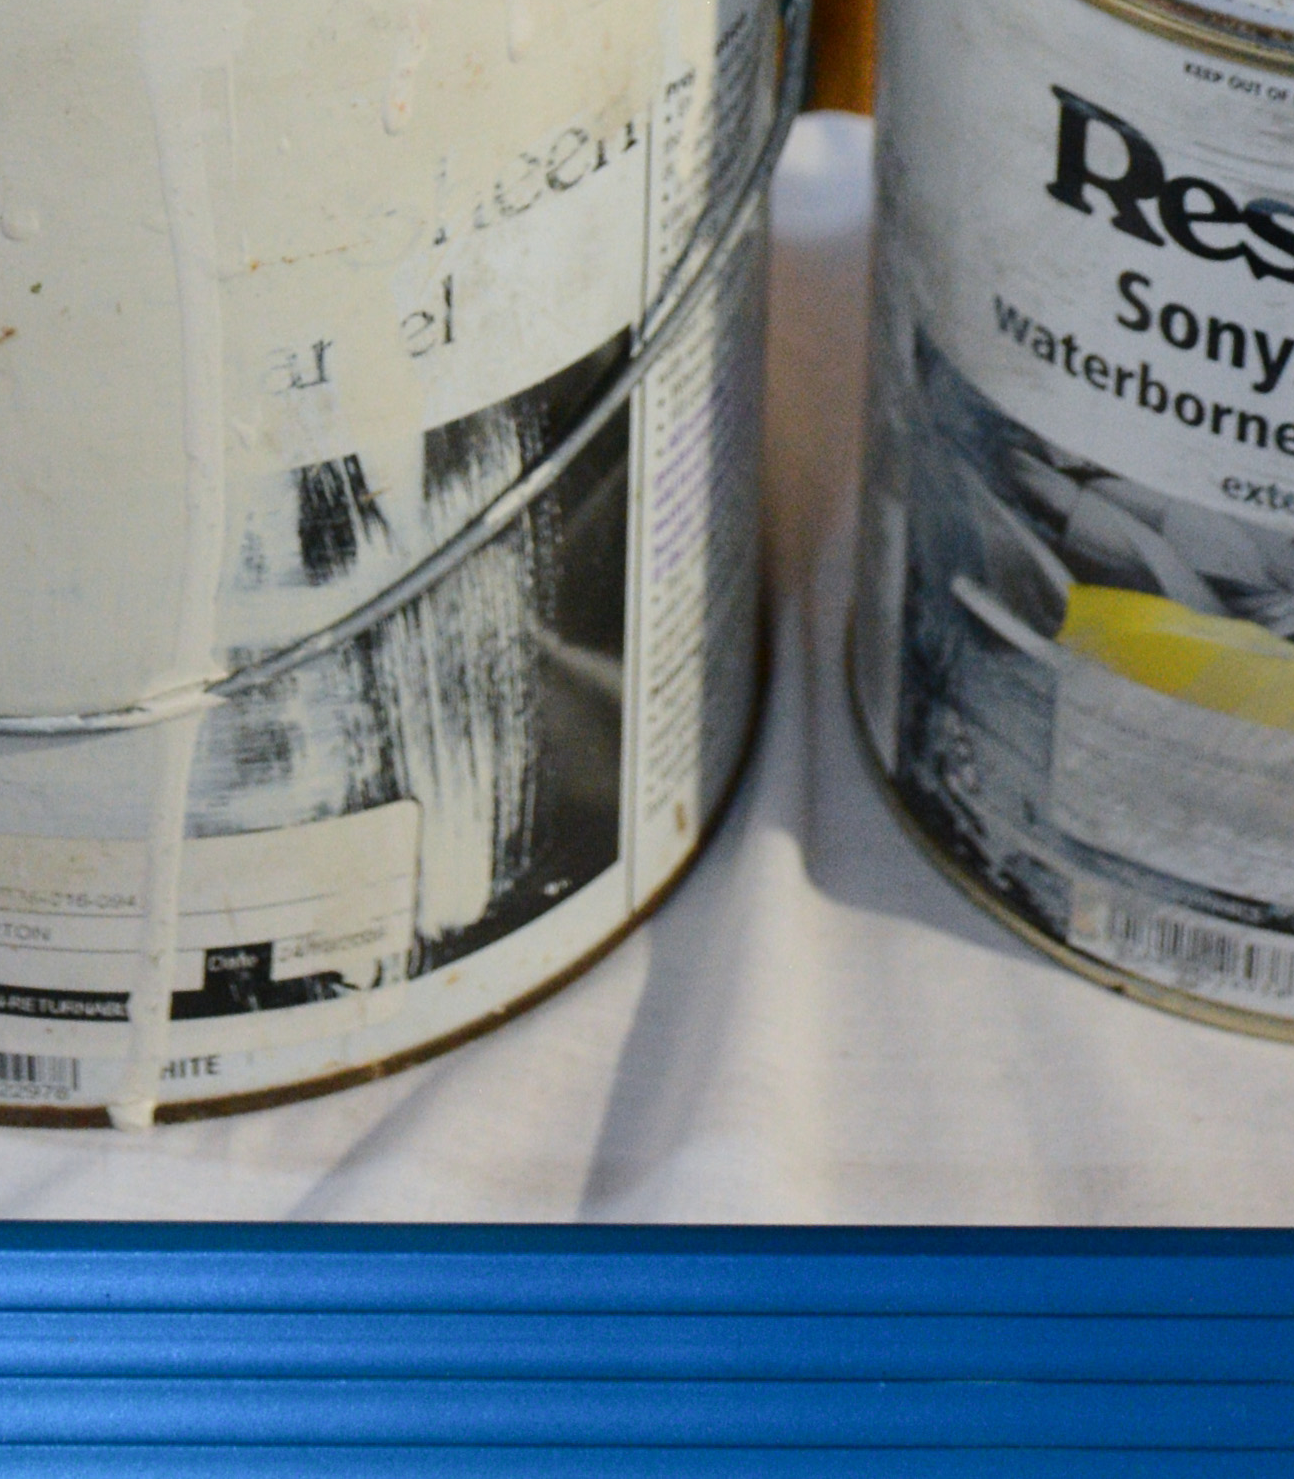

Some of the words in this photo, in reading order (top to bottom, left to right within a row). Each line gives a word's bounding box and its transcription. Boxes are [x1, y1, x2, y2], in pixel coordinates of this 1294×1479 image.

[1182, 59, 1224, 86] KEEP
[1228, 74, 1263, 97] OUT
[1268, 86, 1290, 104] OF
